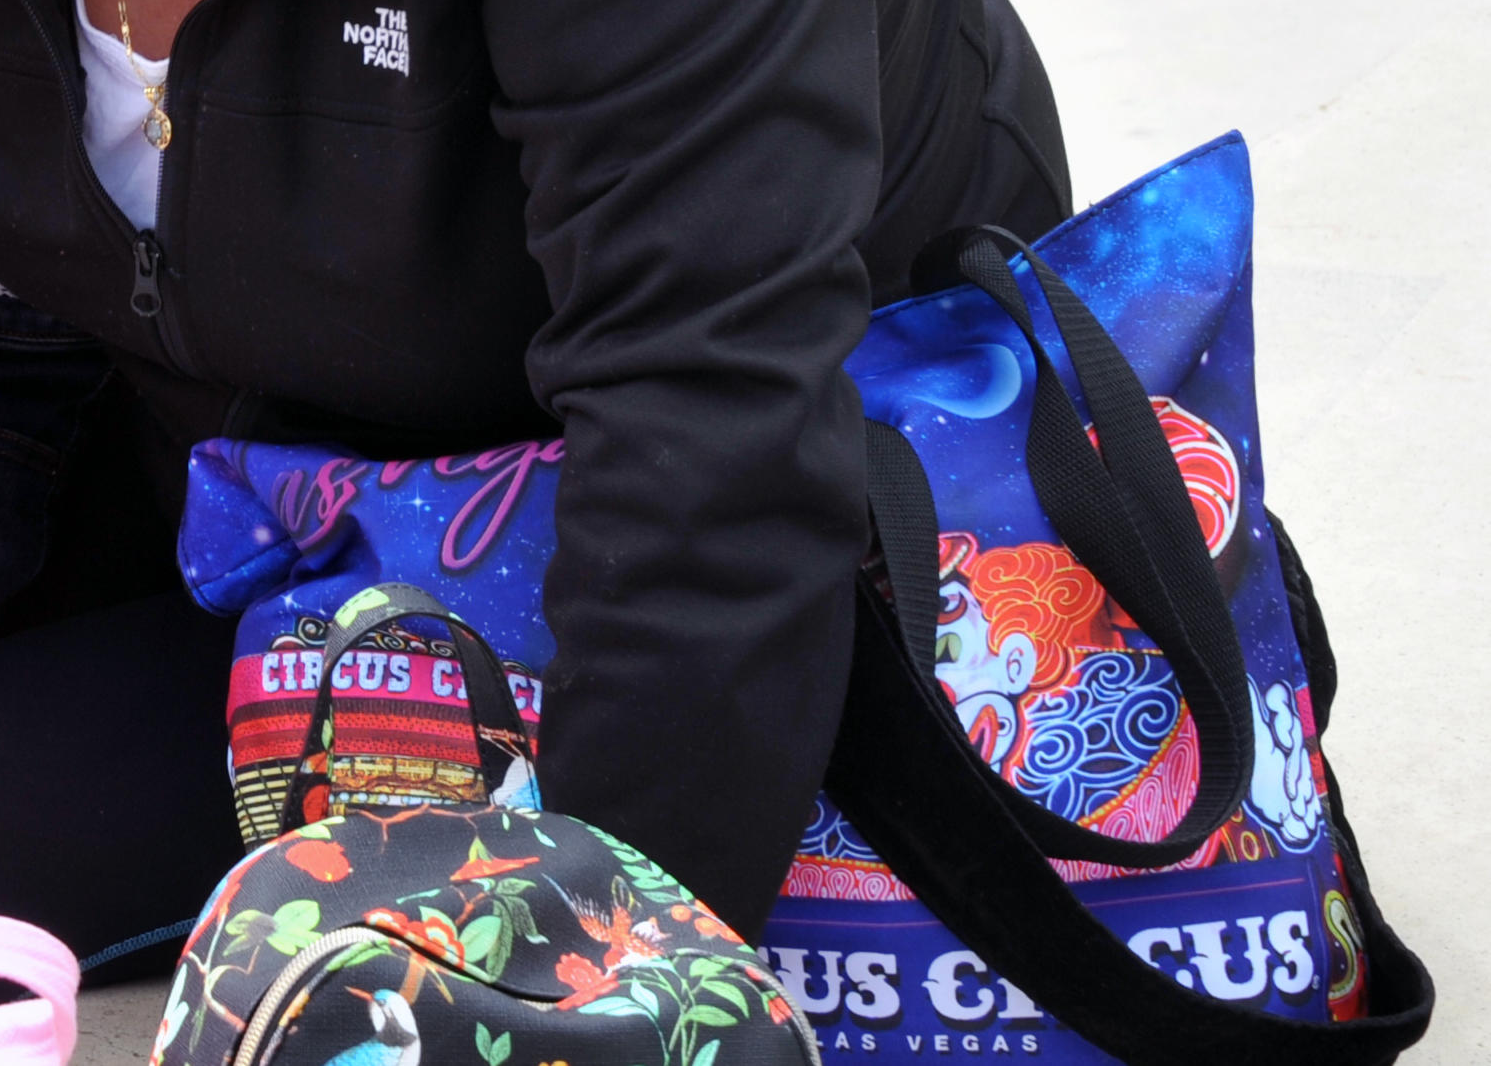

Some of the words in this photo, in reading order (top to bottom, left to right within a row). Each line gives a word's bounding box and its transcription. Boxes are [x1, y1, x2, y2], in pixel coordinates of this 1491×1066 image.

[343, 21, 409, 52] NORTH
[363, 45, 409, 77] FACE
[261, 651, 411, 694] CIRCUS
[907, 1034, 1039, 1052] VEGAS
